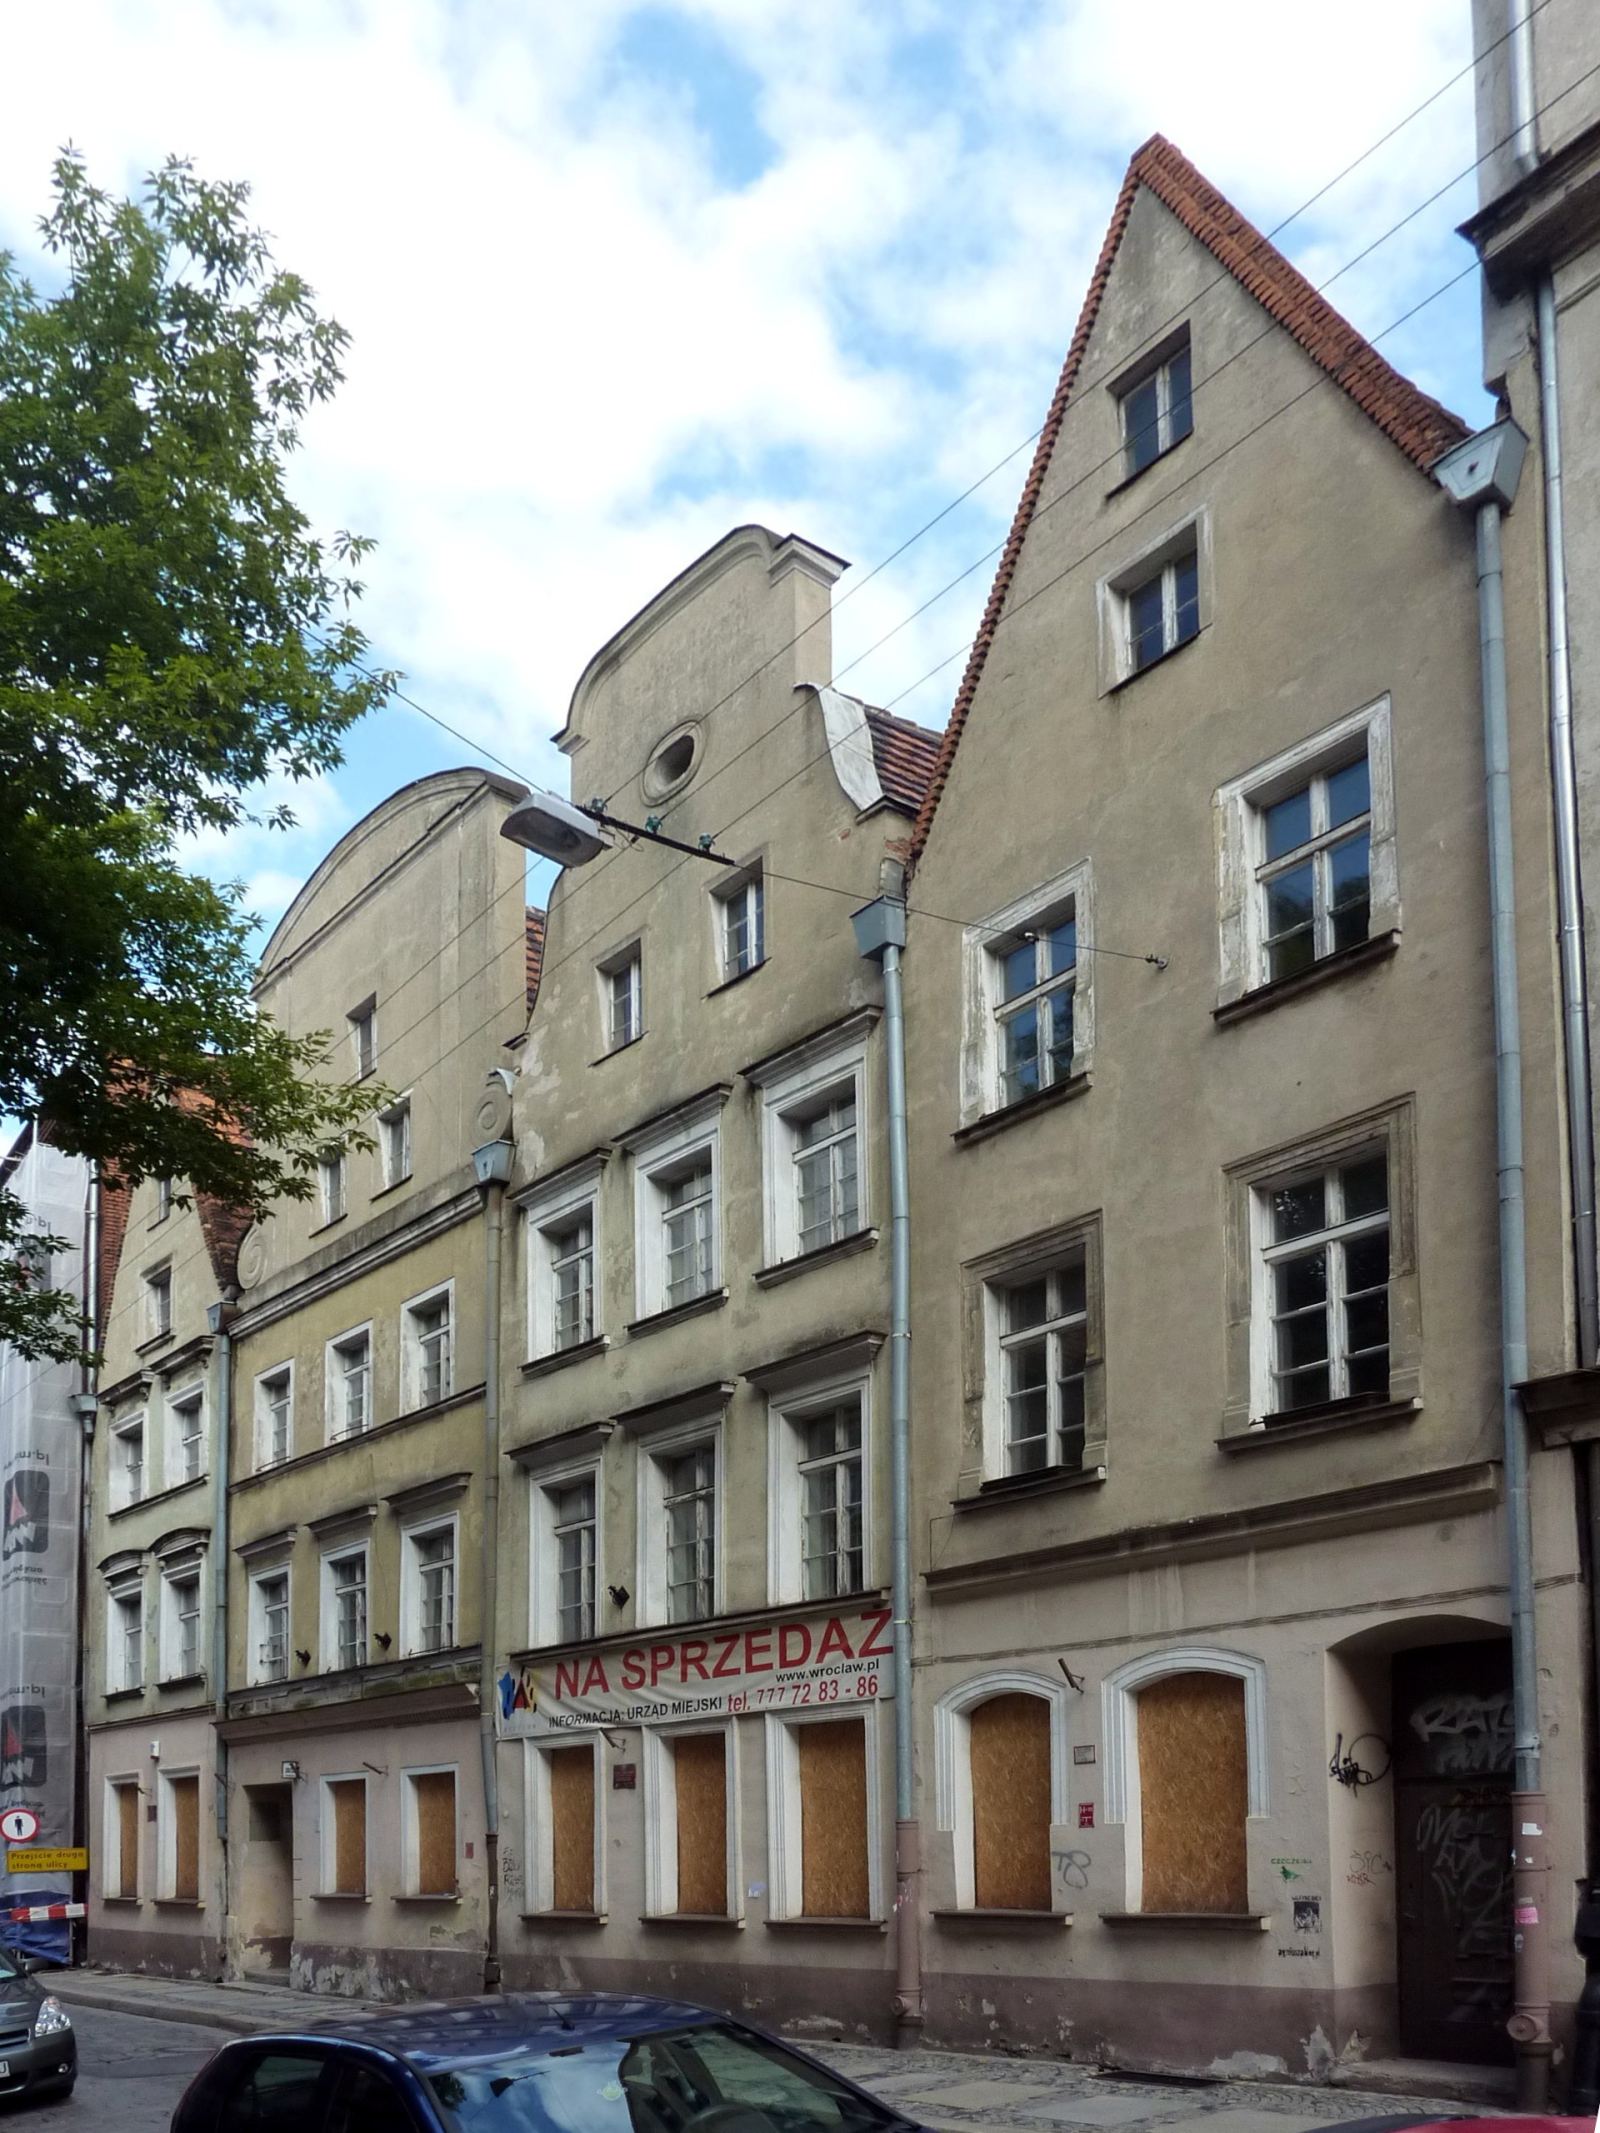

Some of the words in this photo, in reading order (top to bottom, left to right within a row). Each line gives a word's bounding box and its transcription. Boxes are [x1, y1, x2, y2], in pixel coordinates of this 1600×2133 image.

[554, 1655, 610, 1701] NA
[775, 1658, 879, 1683] www.wroclaw.pl
[727, 1691, 750, 1713] tel.
[757, 1687, 785, 1705] 777
[792, 1683, 811, 1705] 72
[818, 1680, 839, 1701] 83
[856, 1675, 878, 1698] 86
[548, 1710, 625, 1728] INFORMACJA:
[627, 1703, 668, 1720] URZĄD
[671, 1696, 722, 1715] MIEJSKI
